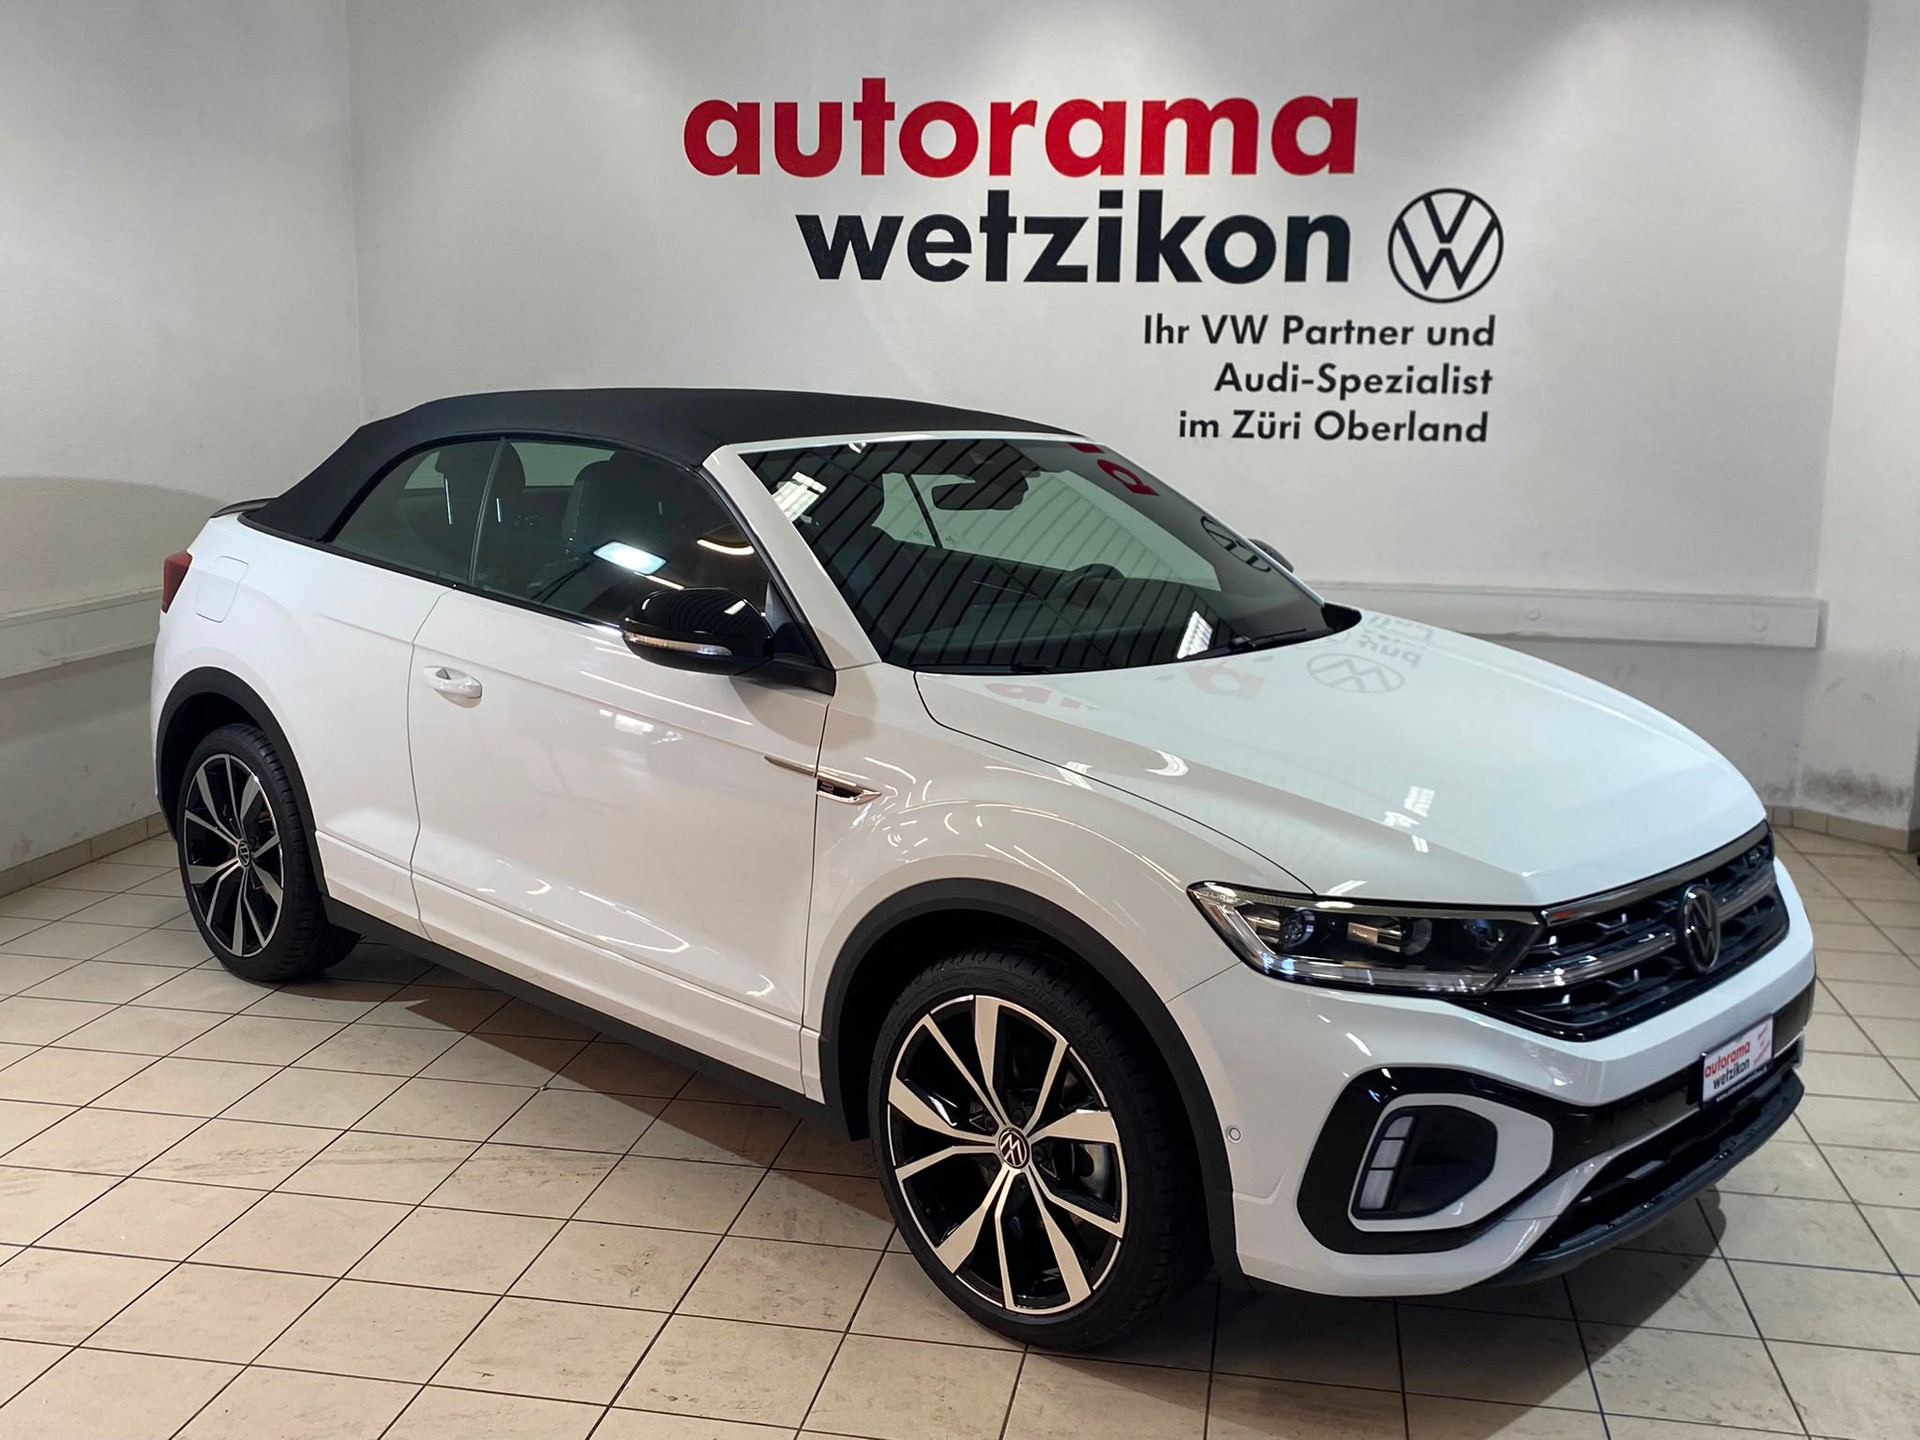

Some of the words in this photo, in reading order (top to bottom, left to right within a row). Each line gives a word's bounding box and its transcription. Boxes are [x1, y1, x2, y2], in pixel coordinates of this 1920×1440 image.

[684, 78, 1358, 178] autorama
[795, 190, 1350, 284] wetzikon
[1144, 313, 1190, 344] Ihr
[1201, 314, 1269, 345] VW
[1282, 314, 1414, 346] Partner
[1427, 314, 1496, 346] und
[1214, 361, 1493, 401] Audi-Spezialist
[1179, 410, 1219, 438] im
[1231, 409, 1301, 440] Züri
[1314, 409, 1488, 443] Oberland
[1704, 1041, 1750, 1077] autorama
[1713, 1058, 1750, 1089] wetzikon
